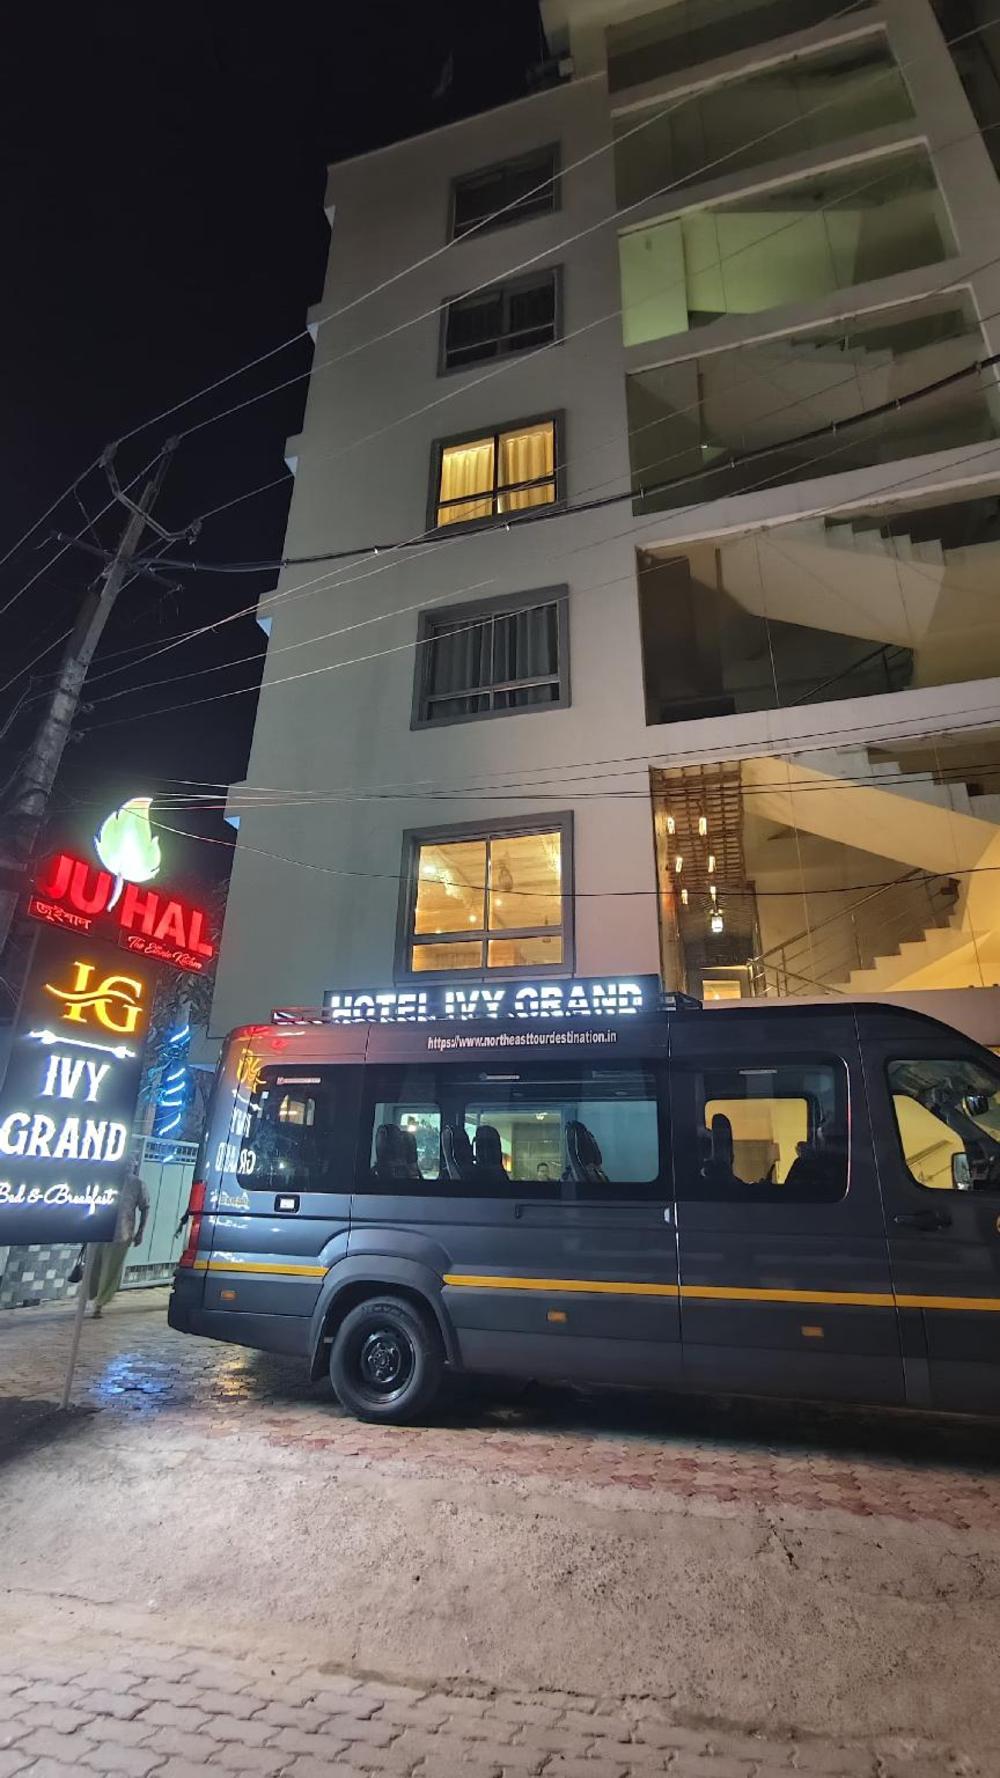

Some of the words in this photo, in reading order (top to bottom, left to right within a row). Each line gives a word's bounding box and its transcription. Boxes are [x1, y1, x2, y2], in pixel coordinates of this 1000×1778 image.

[330, 992, 429, 1023] HOTEL
[445, 990, 506, 1020] IVY
[513, 983, 644, 1018] GRAND
[41, 1054, 111, 1103] IVY
[0, 1111, 128, 1163] GRAND
[27, 1188, 43, 1204] &
[44, 1183, 119, 1216] Breakfast
